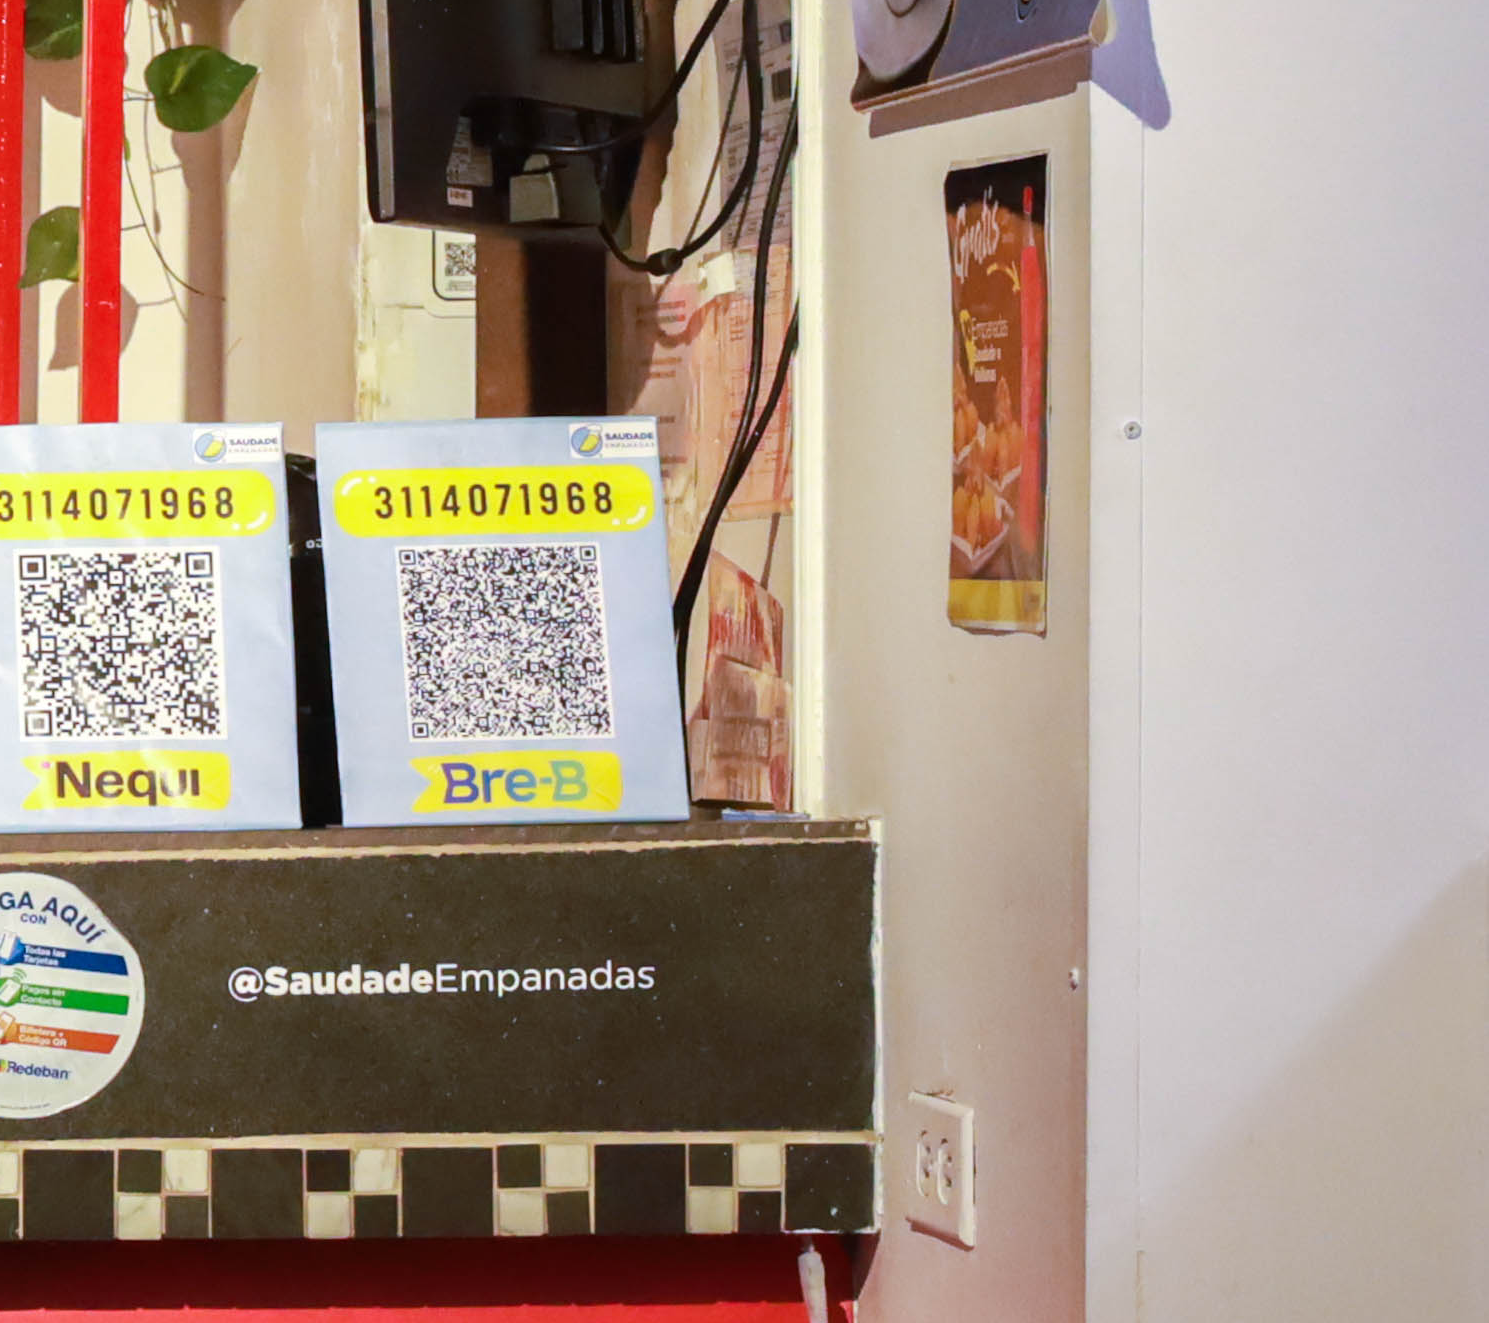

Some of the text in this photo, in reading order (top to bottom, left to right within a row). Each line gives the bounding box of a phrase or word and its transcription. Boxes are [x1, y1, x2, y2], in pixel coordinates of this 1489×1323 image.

[229, 437, 278, 447] SAUDADE
[605, 432, 654, 442] SAUDADE
[374, 482, 613, 519] 3114071968
[55, 761, 201, 806] Nequi
[441, 760, 589, 804] Bre-B
[20, 913, 47, 925] CON
[41, 896, 108, 944] AQUÍ
[228, 960, 656, 1002] @SaudadeEmpanadas
[7, 1059, 70, 1080] Redeban
